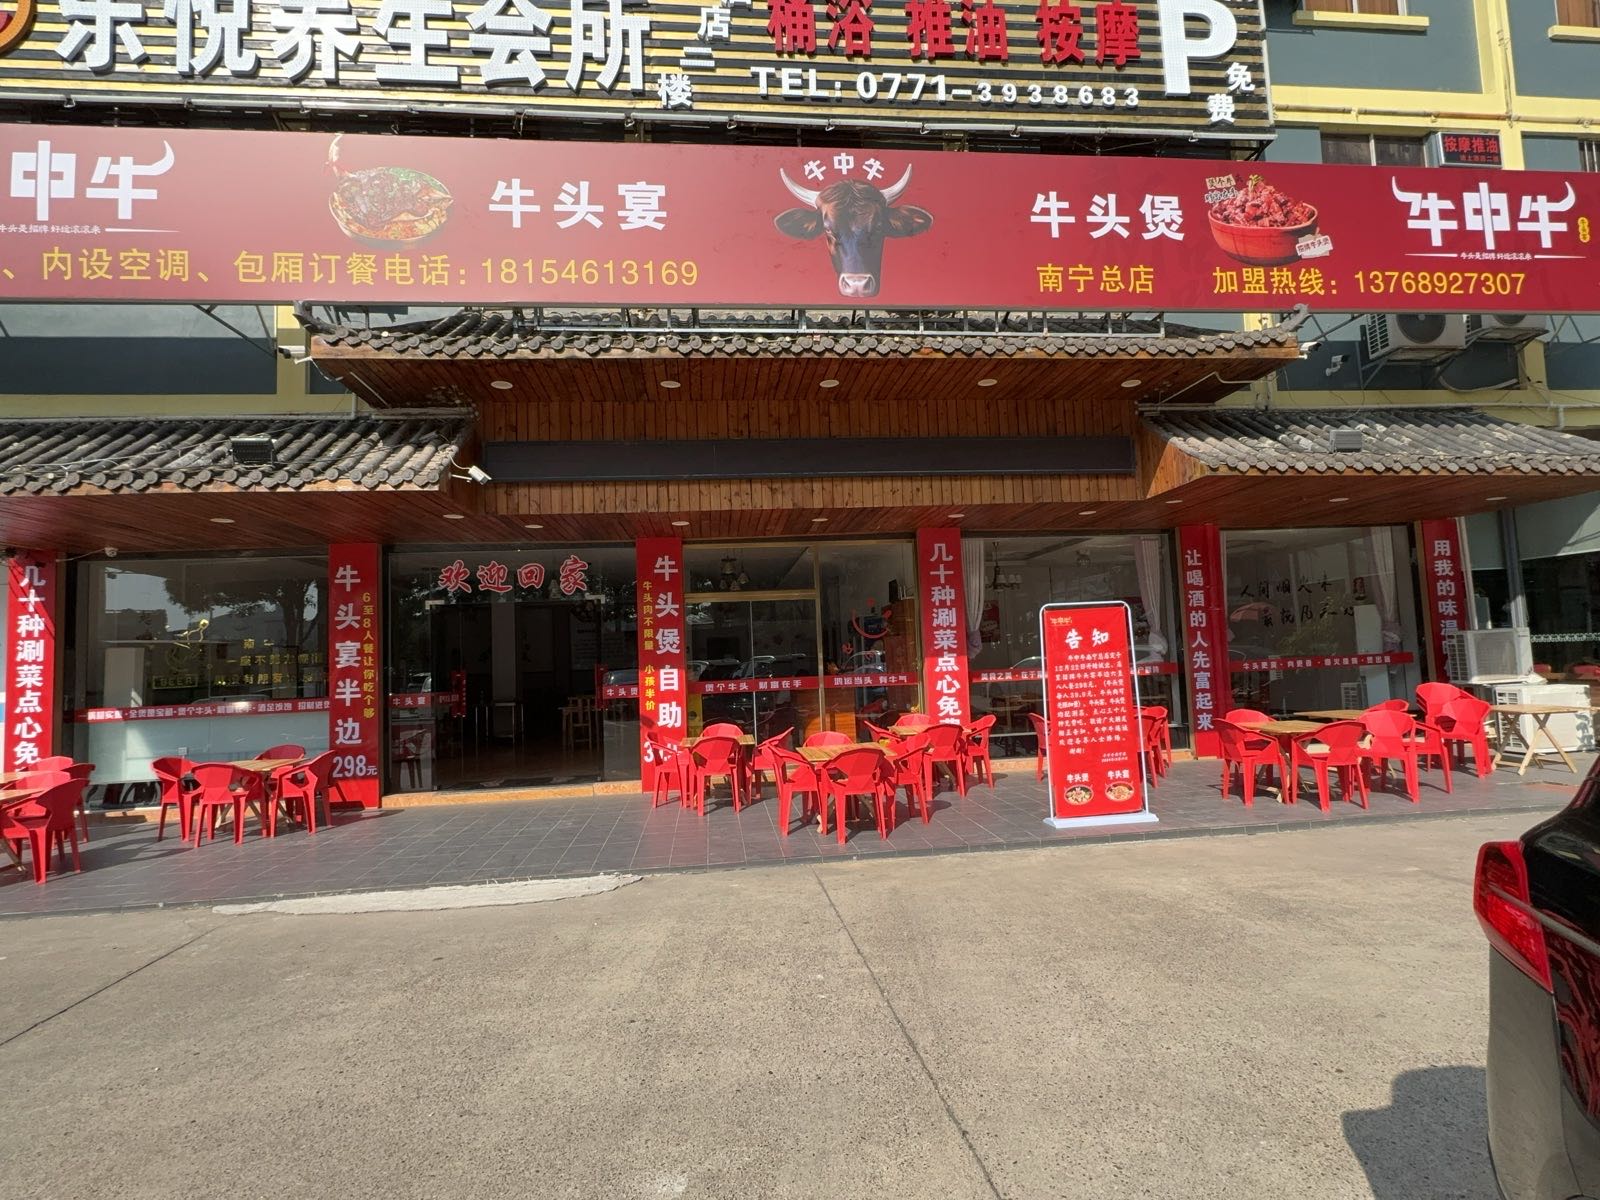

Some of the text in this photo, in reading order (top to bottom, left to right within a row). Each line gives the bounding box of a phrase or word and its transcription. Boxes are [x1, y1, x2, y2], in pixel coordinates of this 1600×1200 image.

[767, 0, 1142, 66] 桶浴 推油 按摩
[1157, 0, 1239, 96] P
[856, 72, 1140, 109] 0771-3938683
[1206, 62, 1256, 124] 免费
[803, 153, 886, 183] 牛中牛
[1444, 136, 1499, 153] 按摩推油
[10, 140, 175, 221] 中牛
[488, 179, 667, 231] 牛头宴
[1030, 190, 1185, 242] 牛头煲
[1391, 175, 1576, 250] 牛中牛
[481, 257, 698, 286] 18154613169
[1037, 264, 1154, 295] 南宁总店
[1354, 271, 1526, 296] 13768927307
[438, 555, 588, 595] 欢迎回家
[334, 564, 362, 745] 牛头宴半边
[643, 581, 655, 711] 牛头肉不限量 小孩半价
[653, 555, 682, 728] 牛头煲自助
[1065, 628, 1109, 649] 告知
[1185, 550, 1214, 731] 让喝酒的人先富起来
[13, 565, 46, 772] 几十种涮菜点心免
[332, 755, 377, 778] 298元
